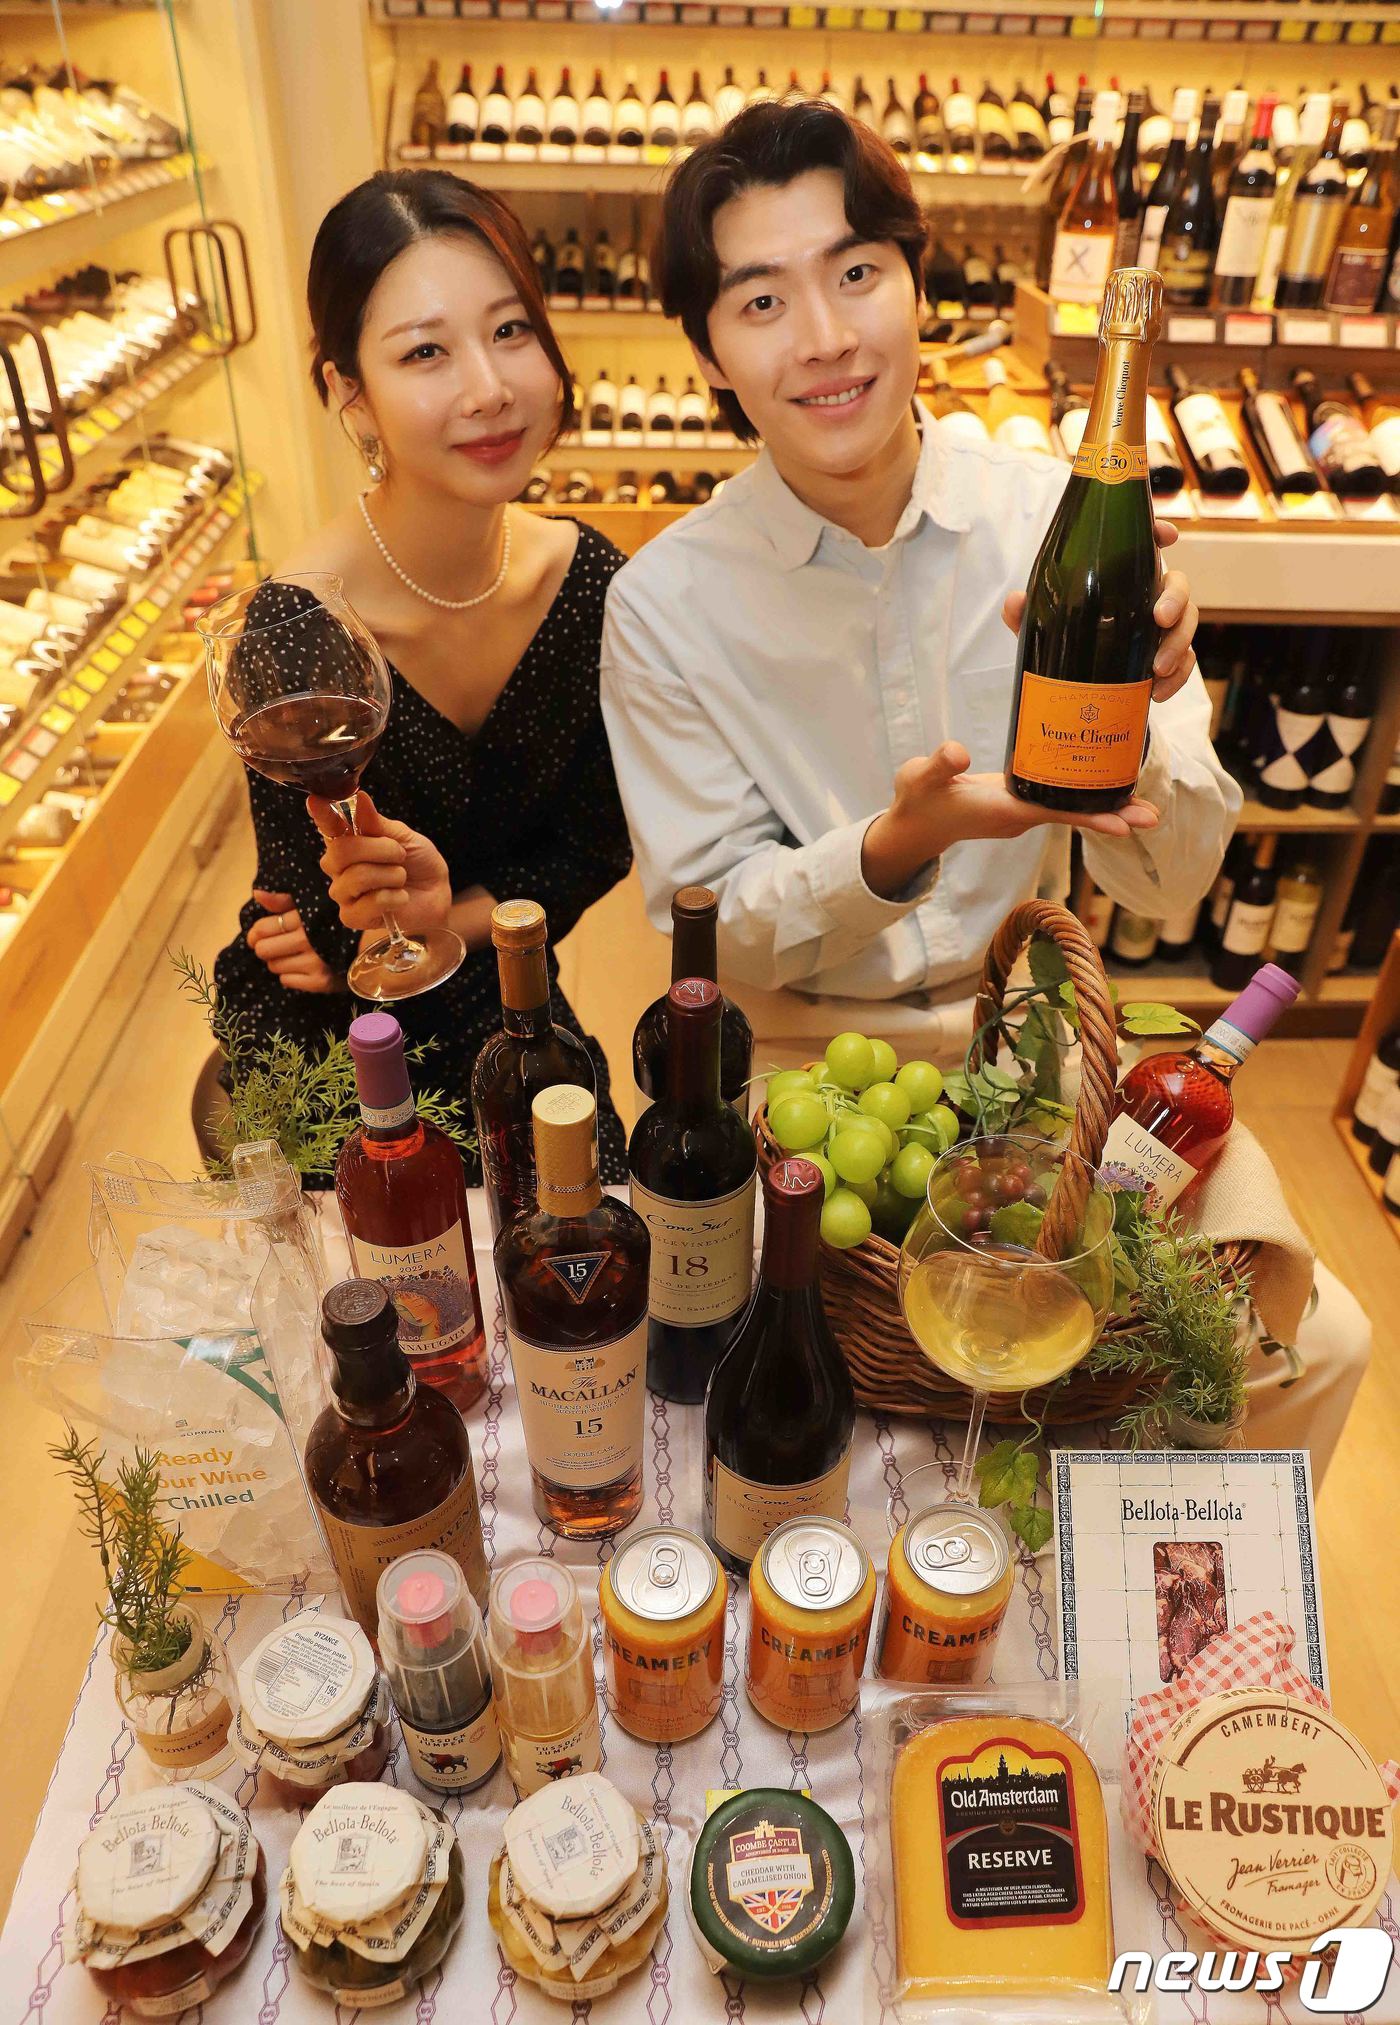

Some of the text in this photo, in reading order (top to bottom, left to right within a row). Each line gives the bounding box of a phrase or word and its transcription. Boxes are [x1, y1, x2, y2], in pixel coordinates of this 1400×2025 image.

[1112, 361, 1130, 428] Veuve Clicquot
[1100, 455, 1127, 470] 250
[1050, 693, 1132, 704] CHAMPAGNE
[1041, 722, 1130, 746] Veuve Clicquot
[1124, 1132, 1183, 1183] LUMERA
[1138, 1162, 1158, 1180] 2022
[647, 1214, 732, 1235] Cono Sur
[680, 1227, 742, 1248] VINEYARD
[370, 1243, 447, 1265] LUMERA
[400, 1264, 424, 1273] 2022
[568, 1262, 587, 1278] 15
[667, 1254, 709, 1278] 18
[530, 1364, 639, 1402] MACALLAN
[569, 1375, 598, 1390] The
[540, 1400, 582, 1410] HIGHLAND
[584, 1398, 612, 1409] SINGLE
[573, 1417, 603, 1436] 15
[157, 1447, 234, 1467] Ready
[158, 1468, 268, 1489] our Wine
[168, 1490, 256, 1512] Chilled
[726, 1494, 771, 1516] SINGLE
[314, 1630, 340, 1646] BYZANCE
[314, 1642, 332, 1654] pepper
[332, 1650, 347, 1660] paste
[204, 1722, 224, 1740] TEA
[1220, 1712, 1322, 1740] CAMEMBERT
[416, 1733, 466, 1743] TUSSOCK
[535, 1732, 584, 1752] TUSSOCK
[950, 1787, 1059, 1809] Old Amsterdam
[1165, 1796, 1203, 1831] LE
[1210, 1792, 1386, 1840] RUSTIQUE
[735, 1838, 798, 1853] COOMBE CASTLE
[968, 1849, 1053, 1870] RESERVE
[1226, 1848, 1320, 1891] Jean Verrier
[732, 1872, 807, 1888] CARAMELISED ONION
[741, 1866, 774, 1877] CHEDDAR
[1266, 1878, 1321, 1897] Fromager
[712, 1900, 726, 1923] UNITED
[1219, 1900, 1273, 1931] FROMAGERIE
[1276, 1922, 1288, 1931] DE
[1318, 1906, 1340, 1924] ORNE
